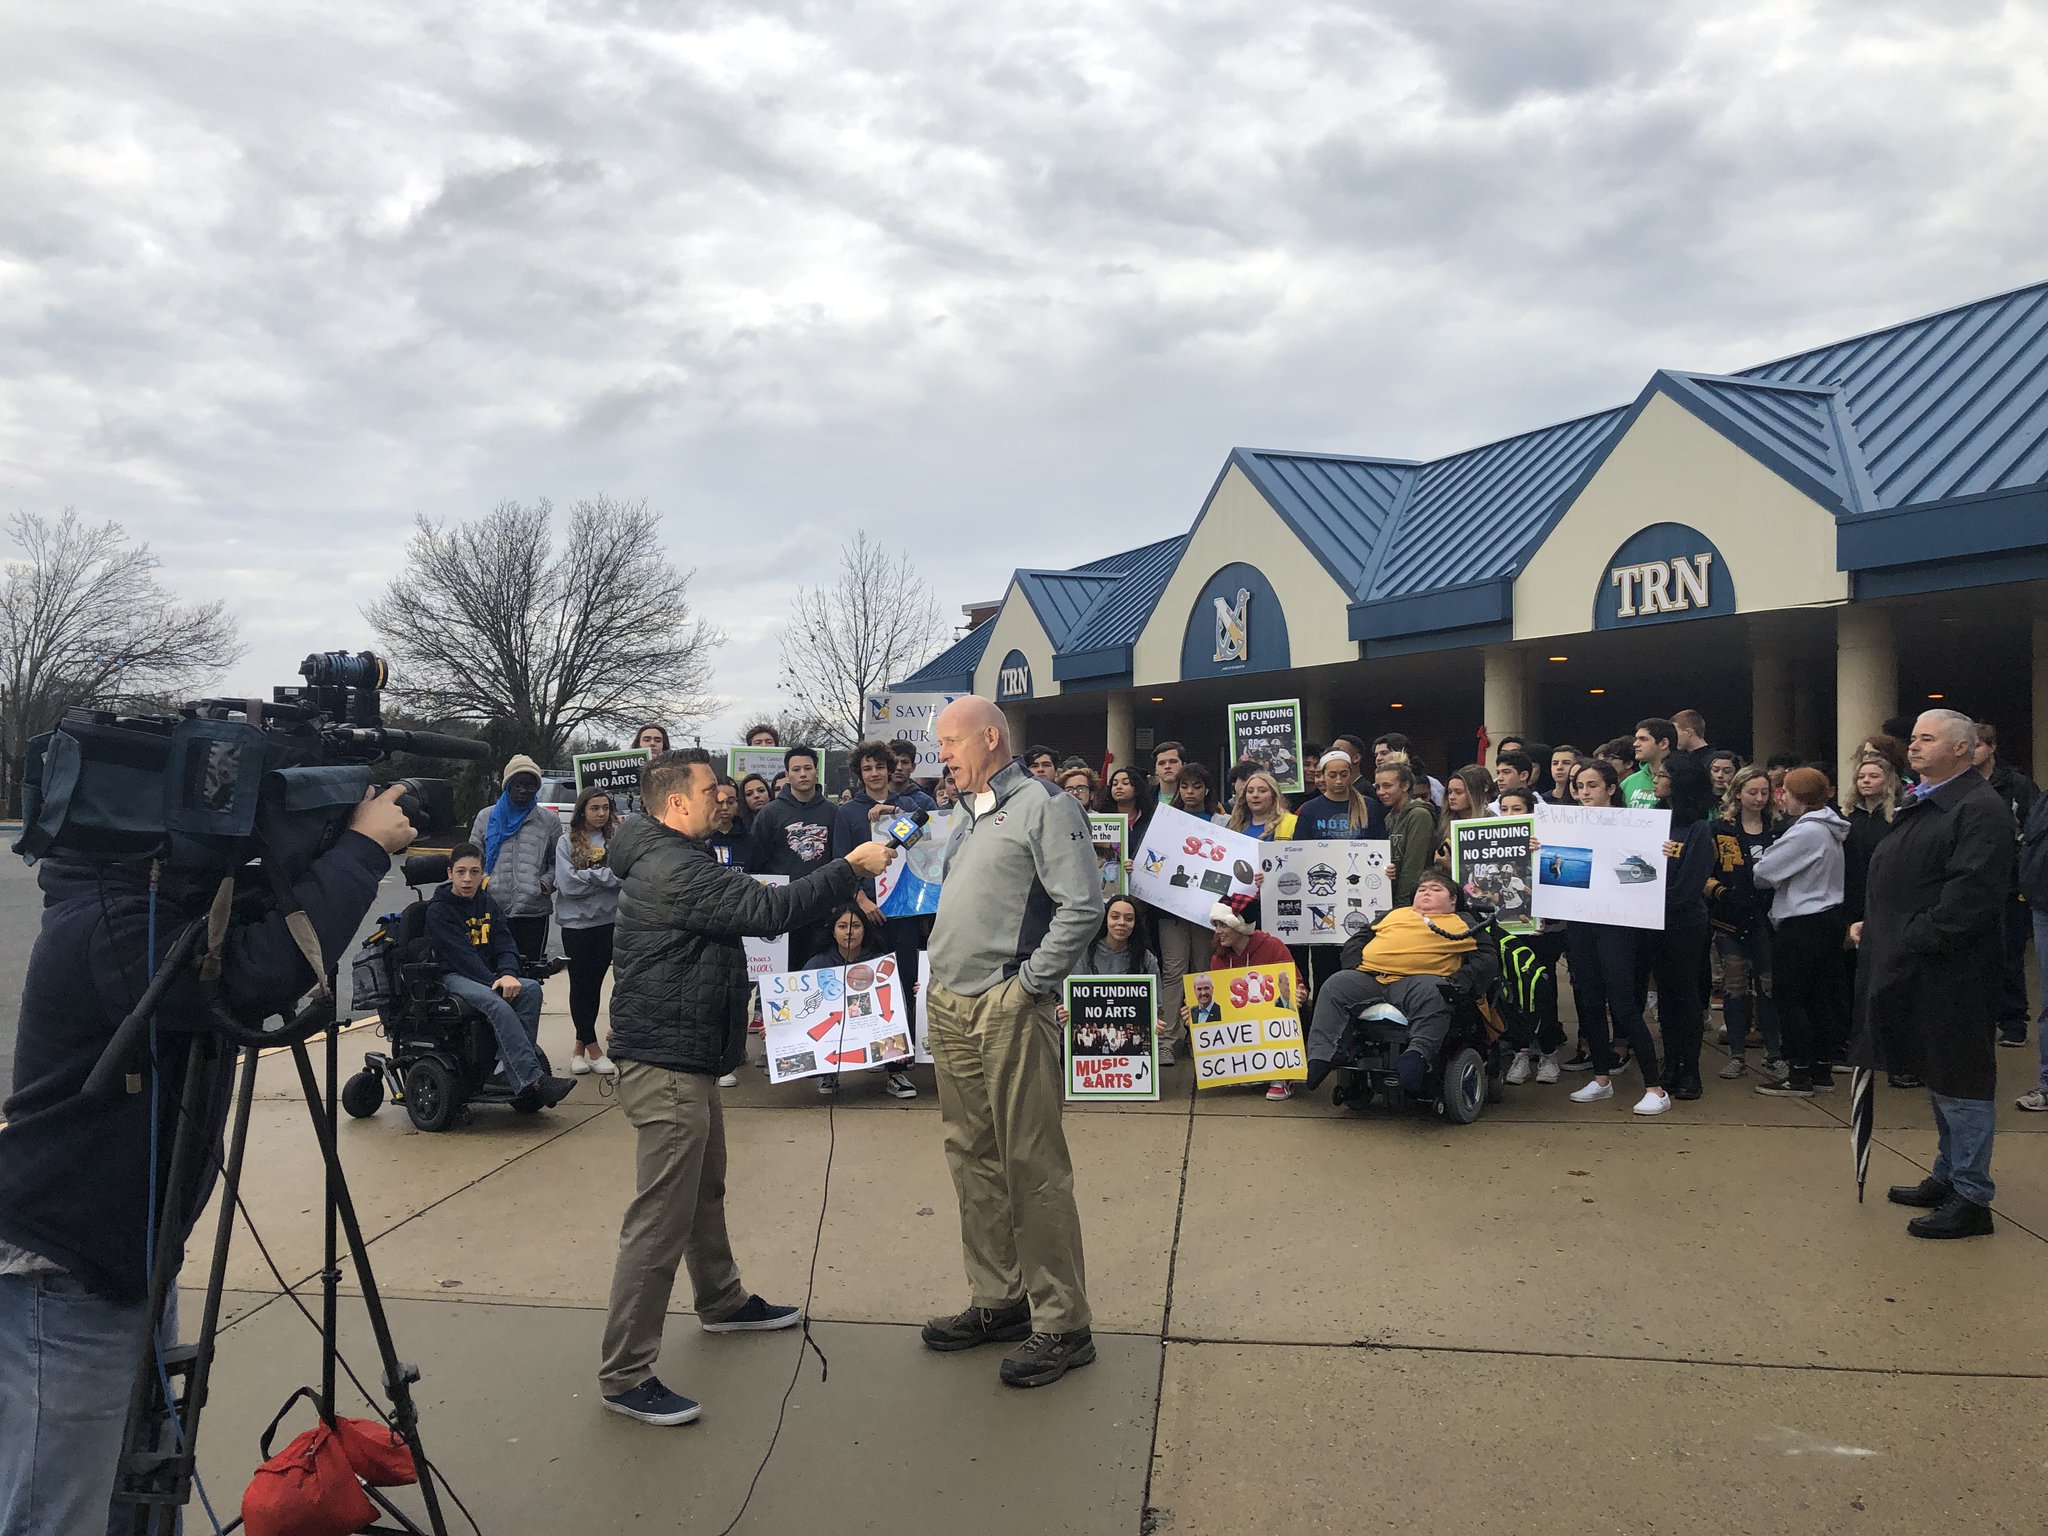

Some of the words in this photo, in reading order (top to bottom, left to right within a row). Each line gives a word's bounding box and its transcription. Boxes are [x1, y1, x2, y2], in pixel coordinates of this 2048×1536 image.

[1611, 552, 1712, 618] TRN
[1001, 665, 1028, 696] TRN
[895, 705, 938, 718] SAVE
[1235, 712, 1248, 721] NO
[1251, 708, 1294, 720] FUNDING
[896, 729, 930, 741] OUR
[1239, 727, 1252, 736] NO
[1254, 724, 1291, 735] SPORTS
[582, 762, 596, 772] NO
[599, 757, 645, 771] FUNDING
[594, 778, 609, 788] NO
[611, 774, 637, 786] ARTS
[893, 821, 910, 838] 12
[900, 817, 914, 829] news
[1104, 823, 1120, 831] Your
[1317, 819, 1349, 830] NOR
[1459, 830, 1475, 842] NO
[1478, 826, 1529, 840] FUNDING
[1183, 837, 1226, 861] SOS
[1463, 849, 1479, 860] NO
[1482, 846, 1526, 859] SPORTS
[1073, 986, 1092, 998] NO
[1093, 986, 1148, 998] FUNDING
[1230, 971, 1275, 1008] SOS
[1085, 1006, 1103, 1018] NO
[1105, 1006, 1137, 1018] ARTS
[1199, 1024, 1253, 1048] SAVE
[1269, 1020, 1300, 1038] OUR
[1076, 1057, 1129, 1076] MUSIC
[1083, 1073, 1133, 1088] &ARTS
